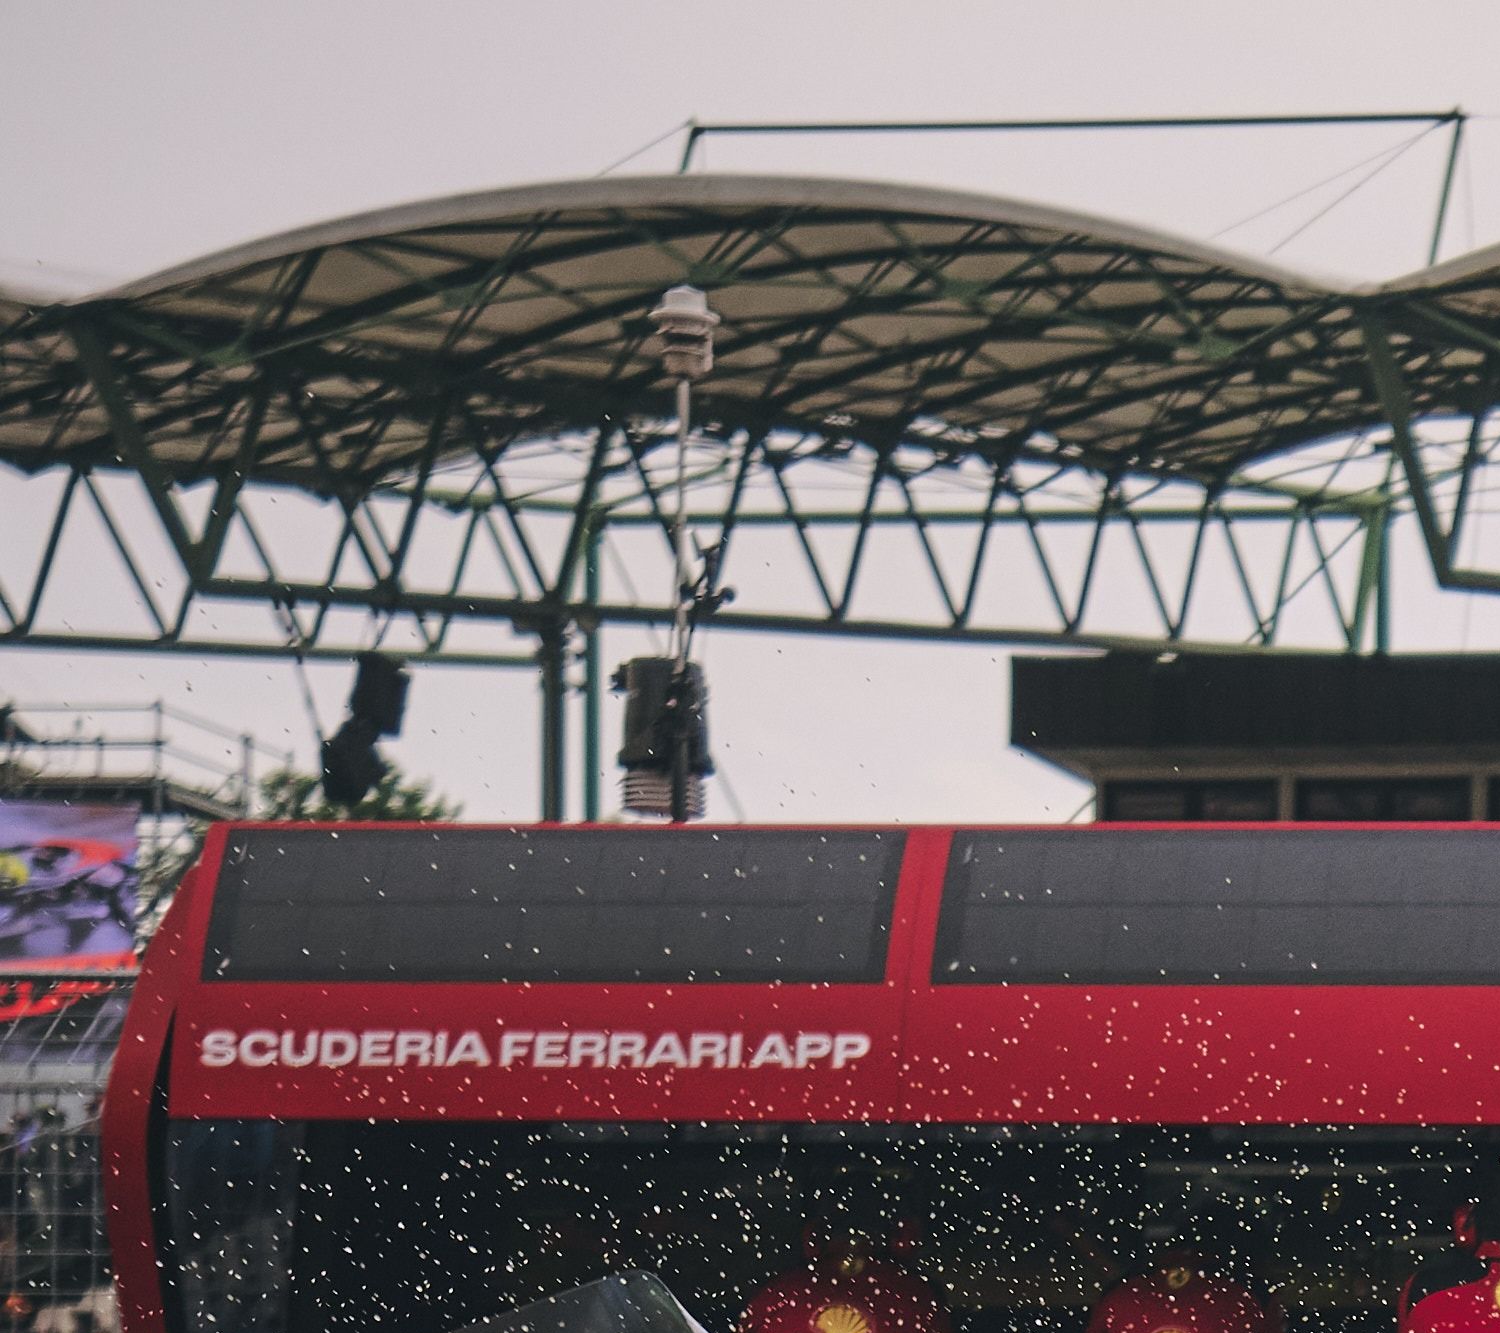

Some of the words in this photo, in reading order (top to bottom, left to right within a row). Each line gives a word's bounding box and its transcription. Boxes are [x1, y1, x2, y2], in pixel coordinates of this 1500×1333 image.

[200, 1030, 492, 1067] SCUDERIA
[500, 1030, 744, 1068] FERRARI
[749, 1032, 871, 1070] APP
